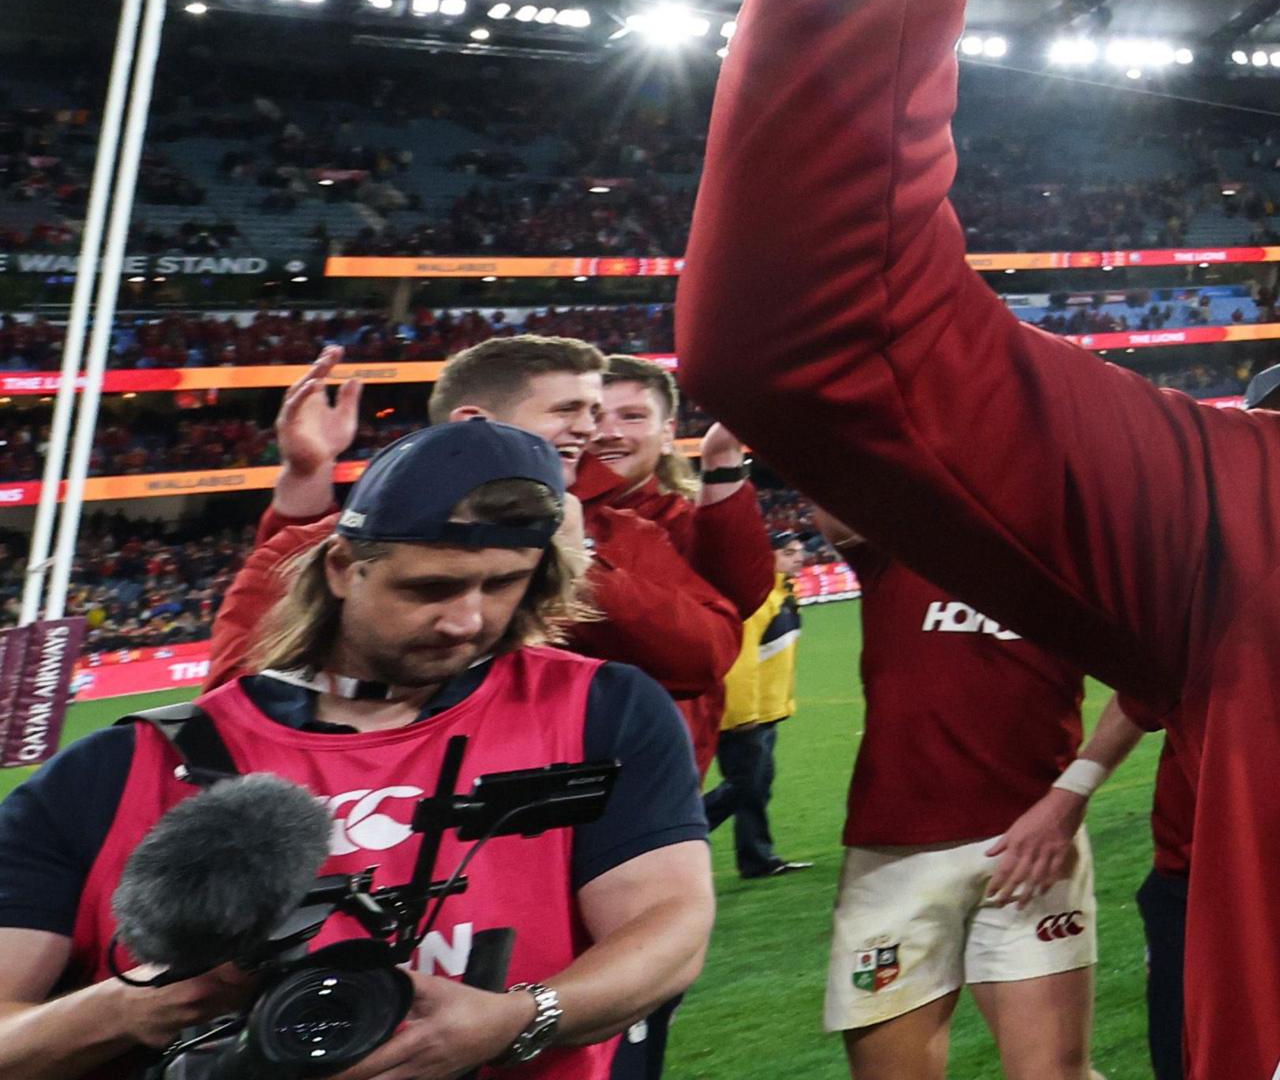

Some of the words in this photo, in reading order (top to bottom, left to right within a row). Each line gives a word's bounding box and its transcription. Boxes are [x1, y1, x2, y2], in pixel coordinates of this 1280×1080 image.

[156, 257, 267, 274] STAND
[1174, 252, 1195, 262] THE
[1129, 333, 1150, 344] THE
[1152, 331, 1186, 343] LIONS
[4, 377, 41, 389] THE
[32, 626, 70, 697] AIRWAYS
[168, 660, 211, 681] TH
[18, 701, 54, 761] QATAR
